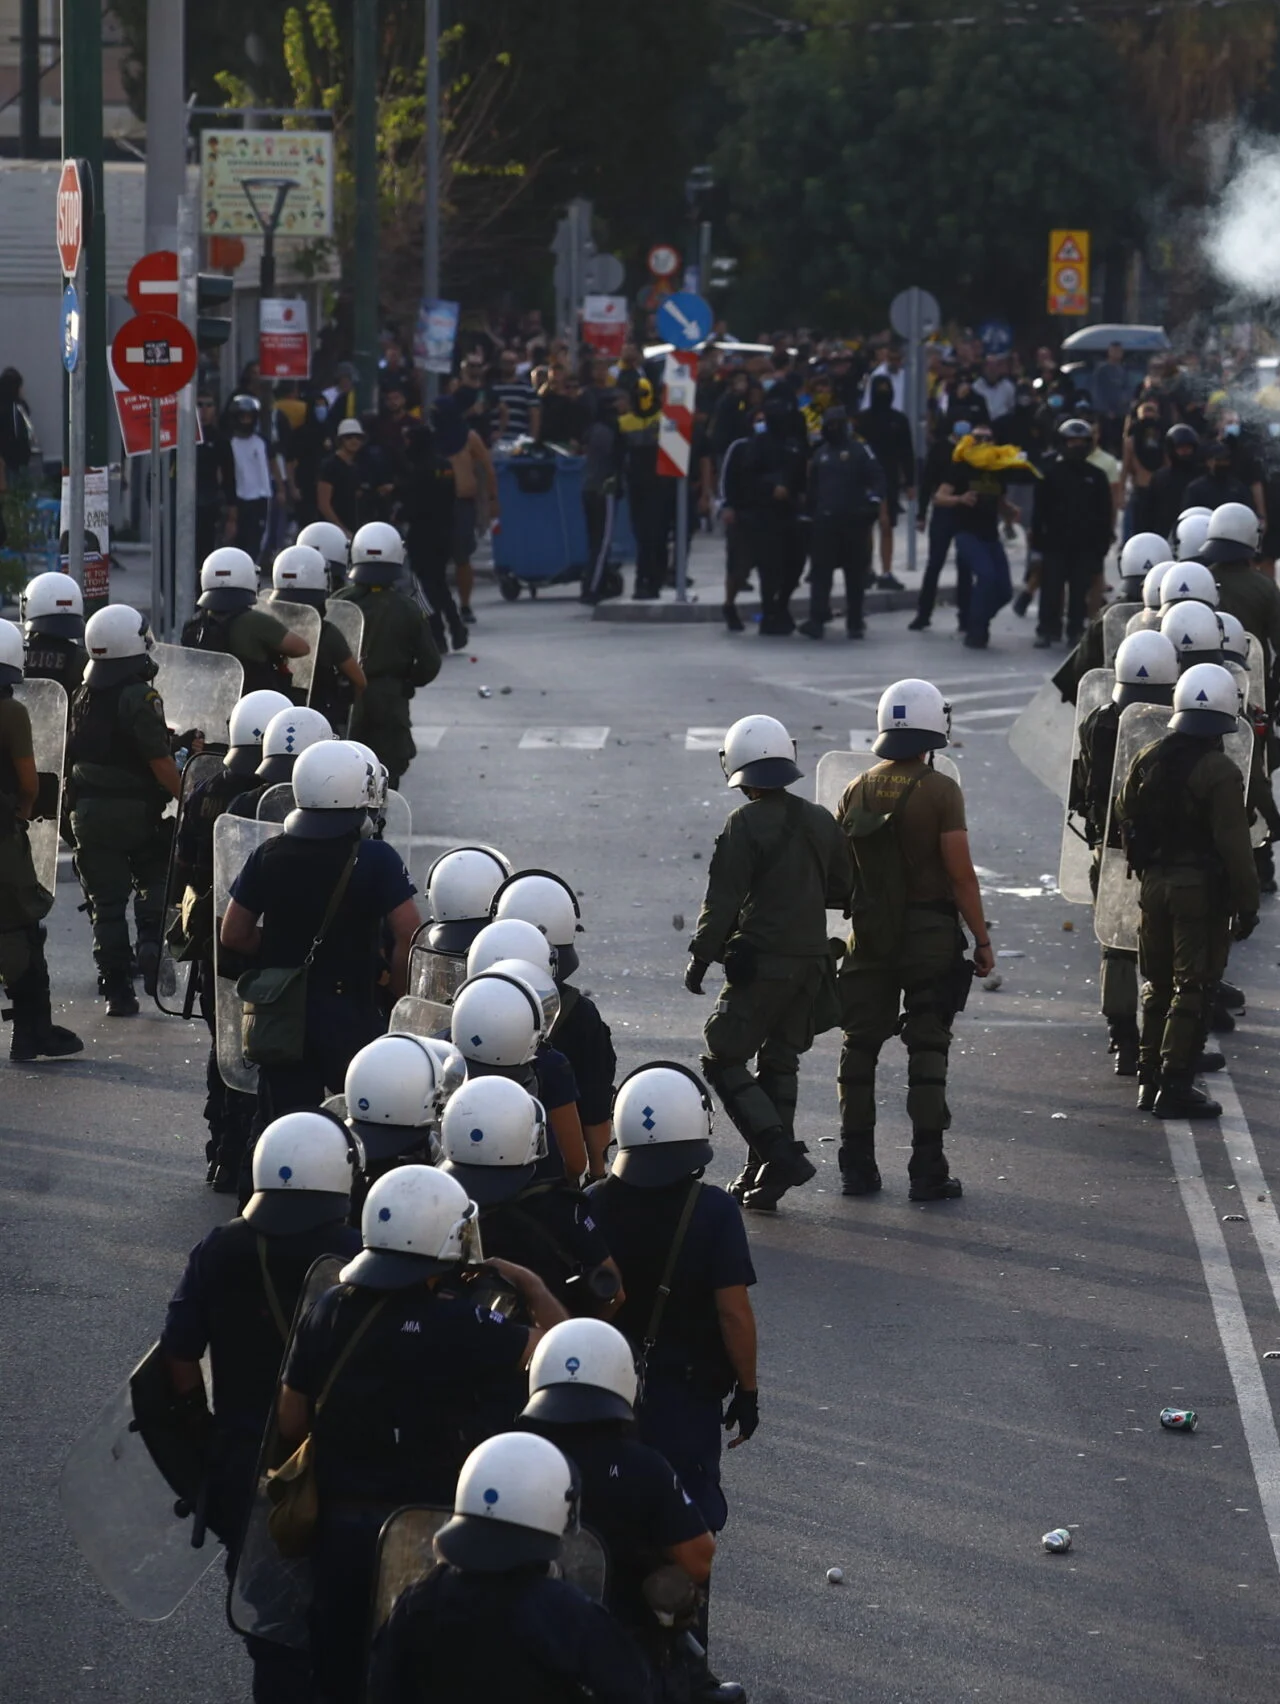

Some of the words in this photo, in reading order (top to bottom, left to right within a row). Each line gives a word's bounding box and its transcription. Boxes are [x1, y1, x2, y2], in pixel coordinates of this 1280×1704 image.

[60, 191, 79, 246] STOP
[29, 651, 66, 668] LICE
[401, 1321, 420, 1332] ΜΙΑ
